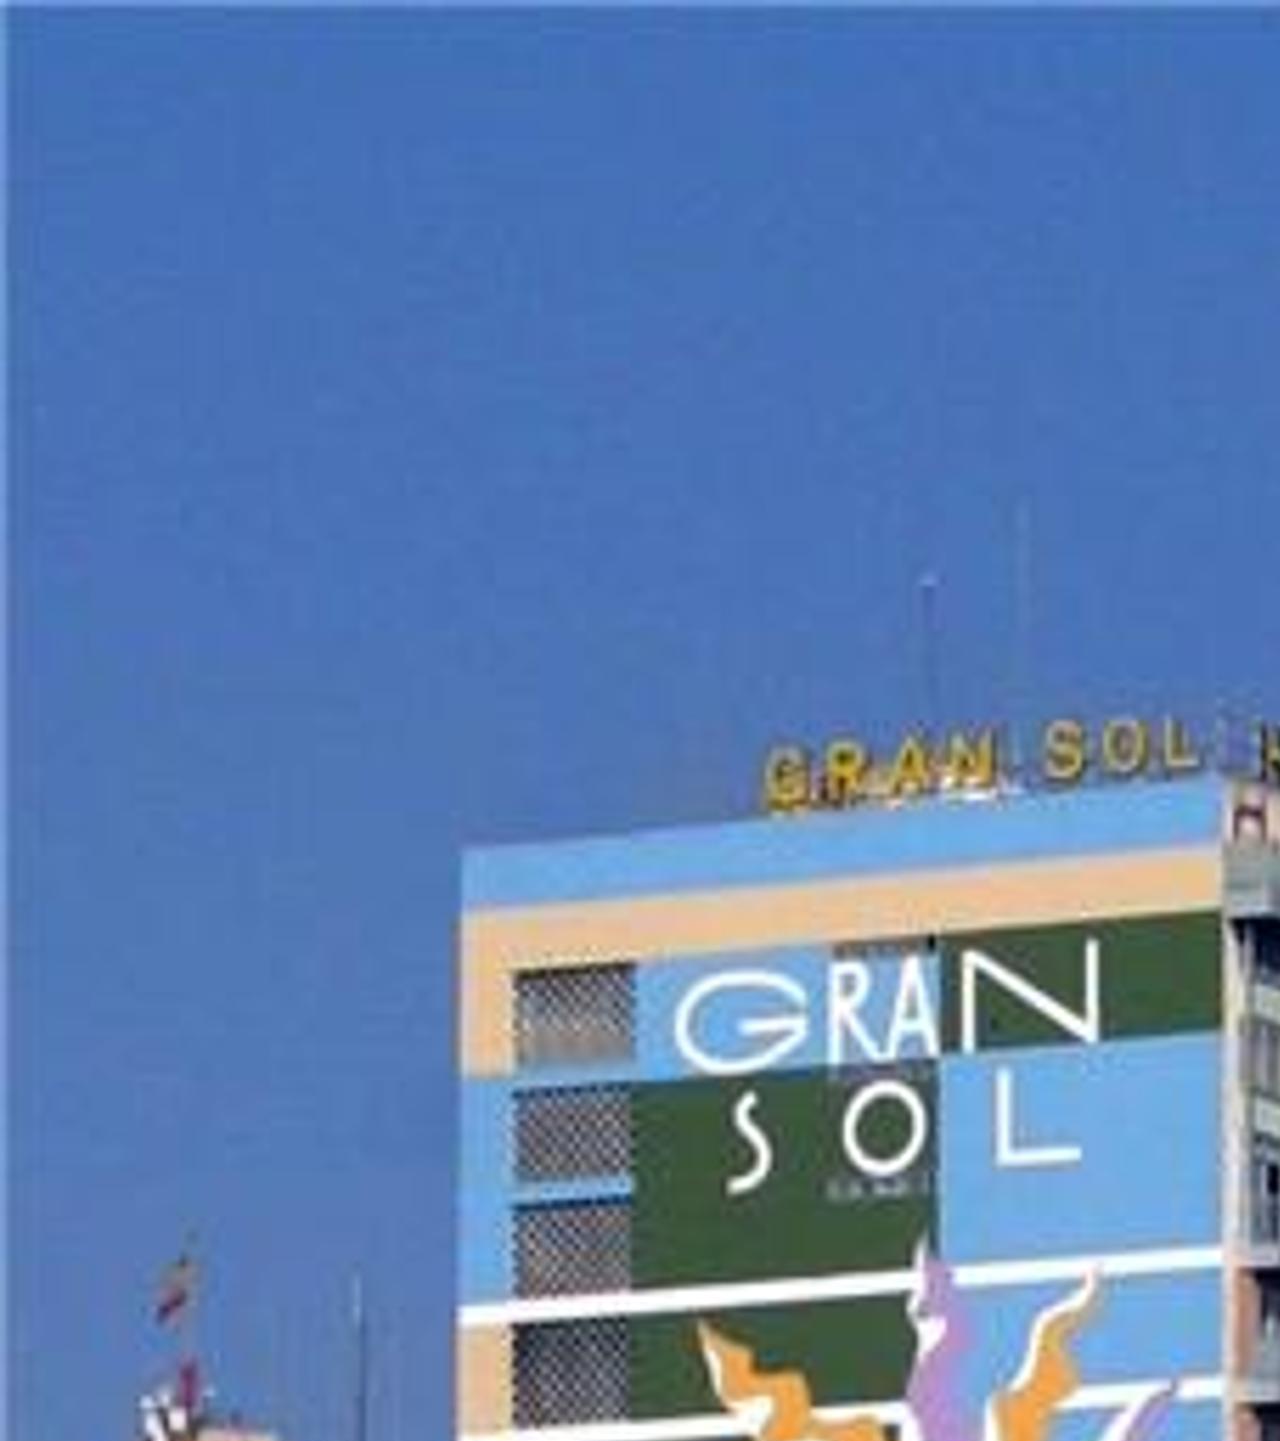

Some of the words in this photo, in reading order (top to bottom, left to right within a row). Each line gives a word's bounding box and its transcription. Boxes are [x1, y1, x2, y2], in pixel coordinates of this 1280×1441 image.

[764, 730, 998, 816] GRAN
[1043, 697, 1199, 780] SOL
[674, 938, 1100, 1077] GRAN
[726, 1066, 1083, 1196] SOL
